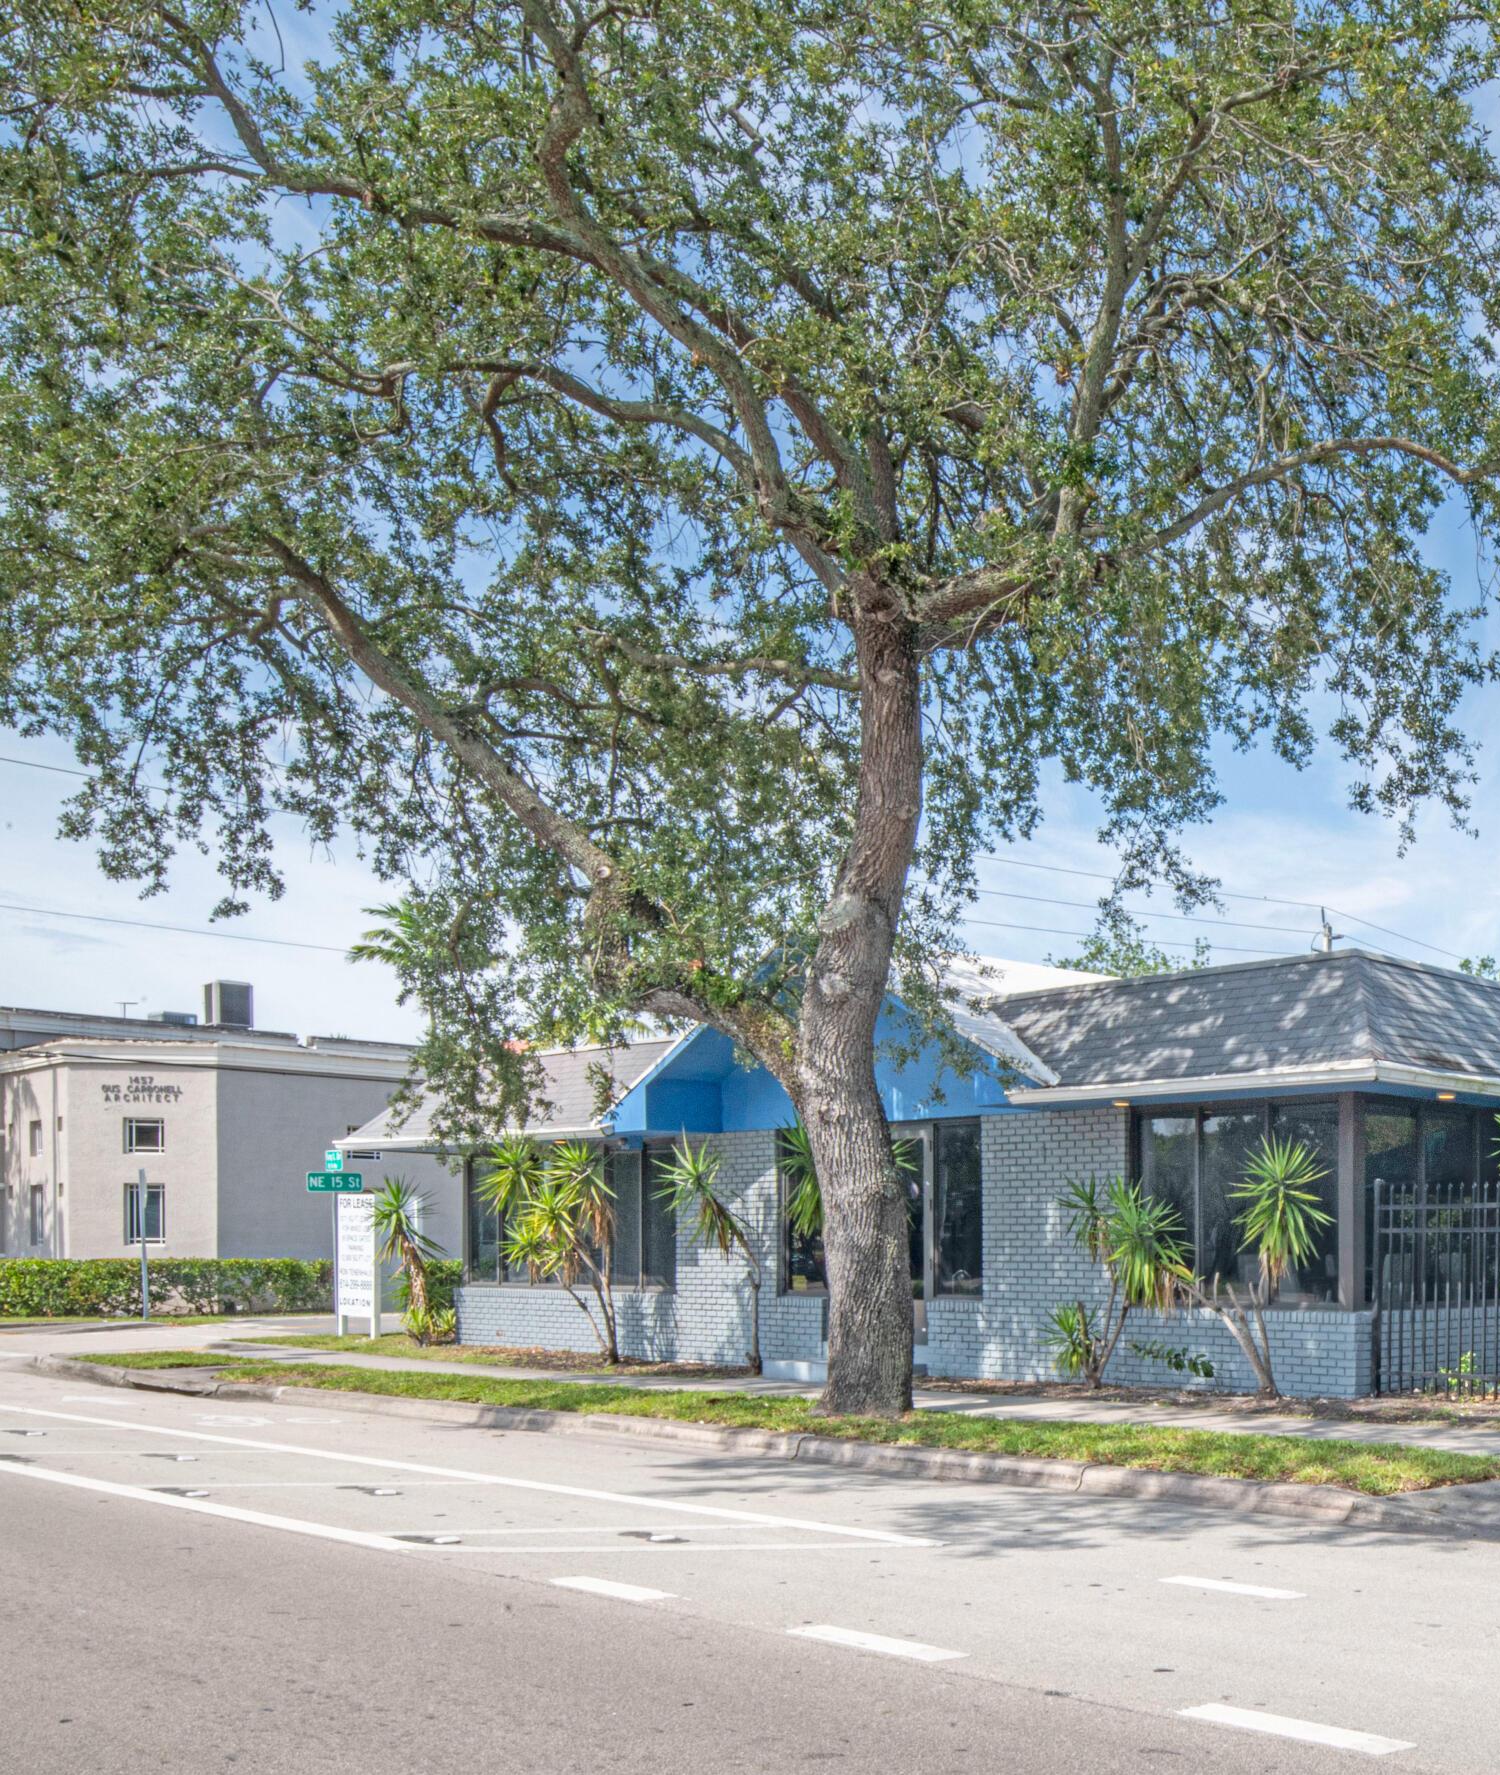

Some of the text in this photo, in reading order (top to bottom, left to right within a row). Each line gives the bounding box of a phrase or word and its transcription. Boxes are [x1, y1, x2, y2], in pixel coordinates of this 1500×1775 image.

[104, 1094, 179, 1103] ARCHITECT
[309, 1176, 360, 1188] NE 15 St
[340, 1198, 374, 1209] FOR LEASE
